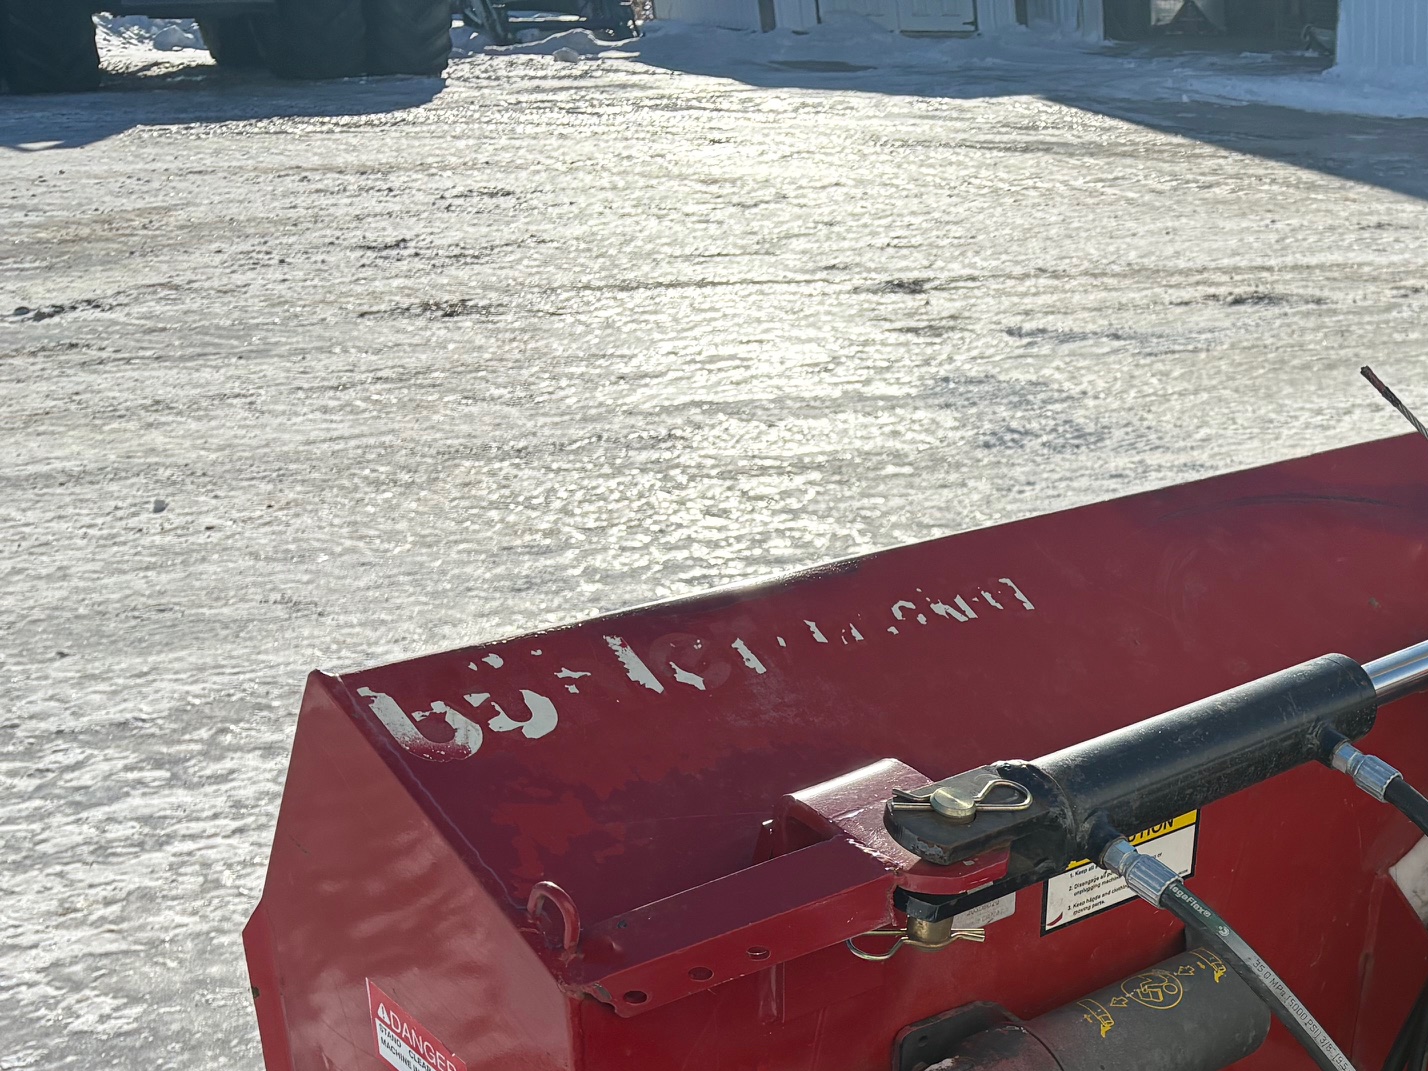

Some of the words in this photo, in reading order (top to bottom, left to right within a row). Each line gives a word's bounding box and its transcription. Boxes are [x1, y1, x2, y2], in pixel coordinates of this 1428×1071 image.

[1075, 868, 1088, 877] Keep
[1073, 876, 1100, 890] Disengage
[1073, 883, 1101, 897] unplugging
[1072, 899, 1085, 908] Keep
[1101, 889, 1111, 899] and
[1073, 905, 1091, 916] moving
[1269, 978, 1287, 997] MPa
[378, 1024, 402, 1048] STAND
[381, 1036, 413, 1070] MACHINE
